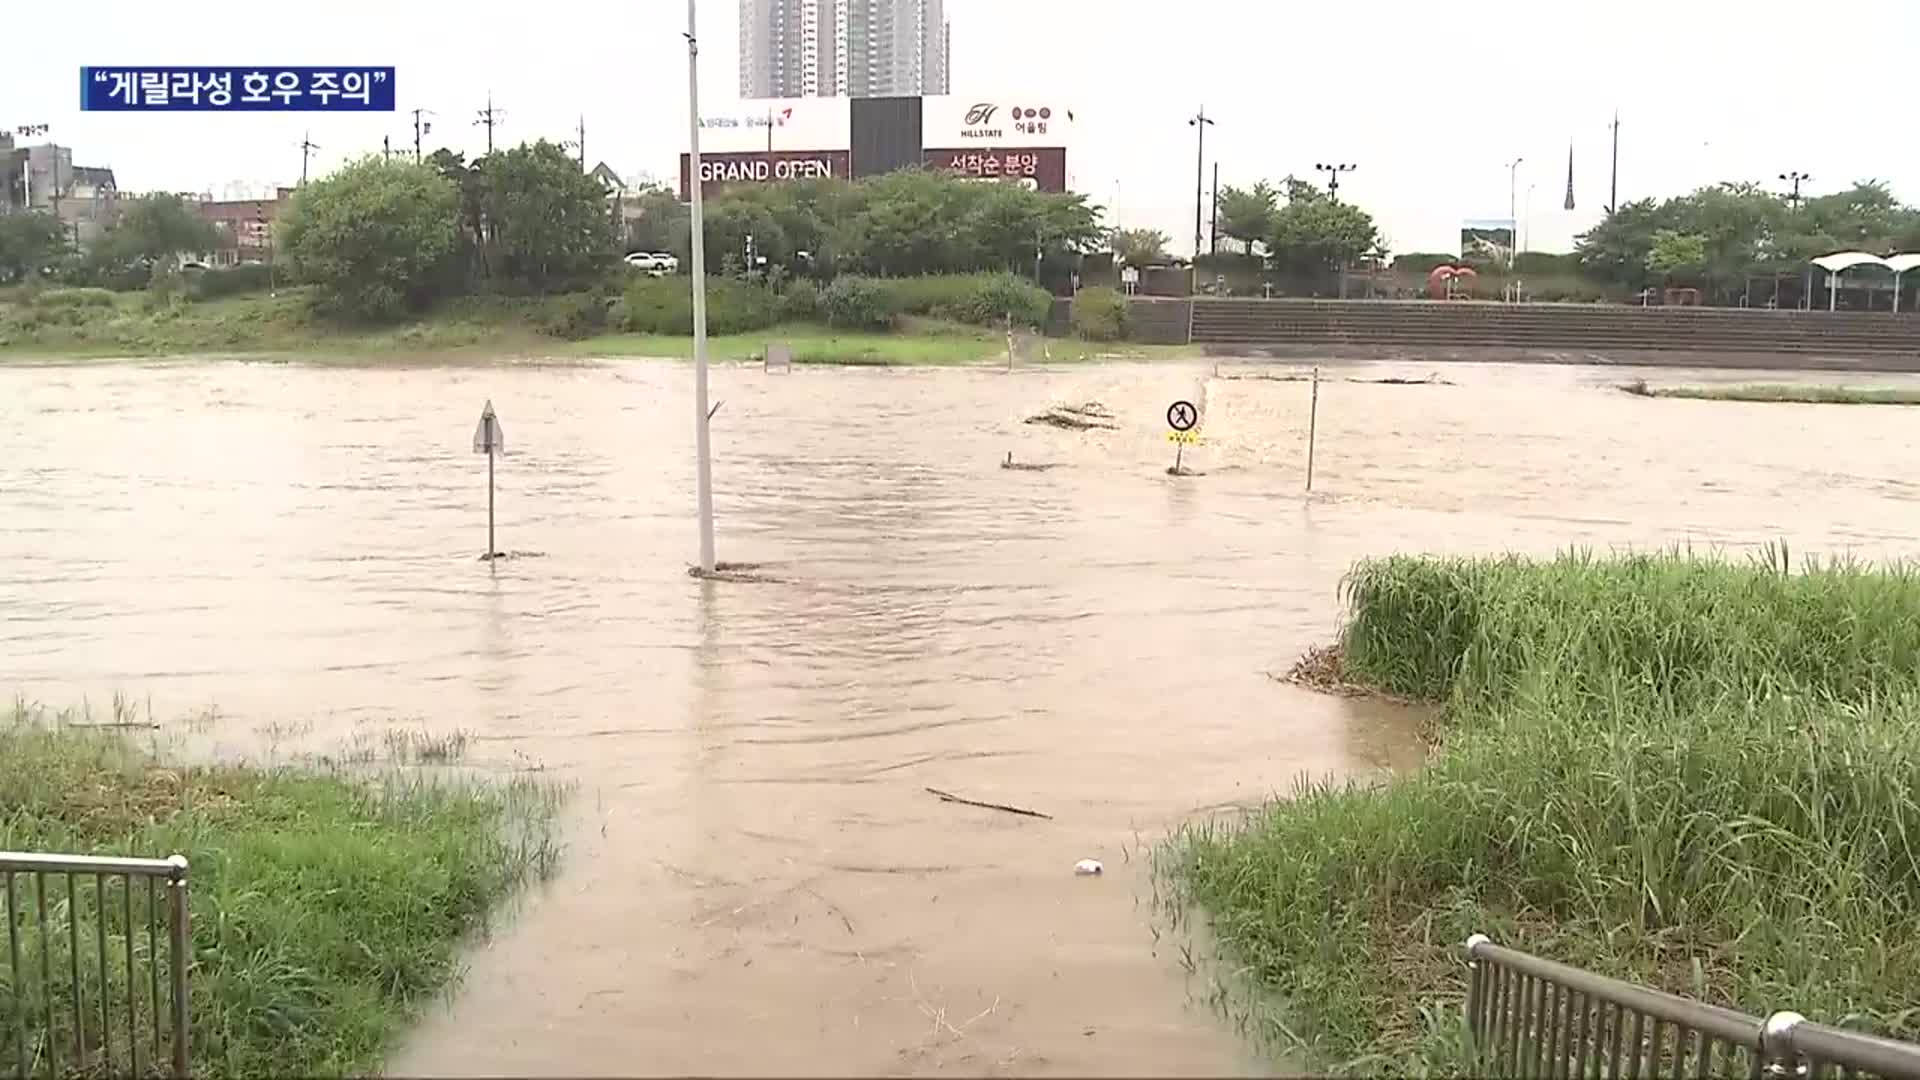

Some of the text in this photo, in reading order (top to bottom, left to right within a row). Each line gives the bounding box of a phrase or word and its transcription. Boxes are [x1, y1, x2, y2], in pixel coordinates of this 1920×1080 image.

[960, 129, 1003, 138] HILLSTATE
[1015, 121, 1047, 134] 어울림
[699, 159, 832, 182] GRAND OPEN
[1004, 153, 1038, 175] 분양
